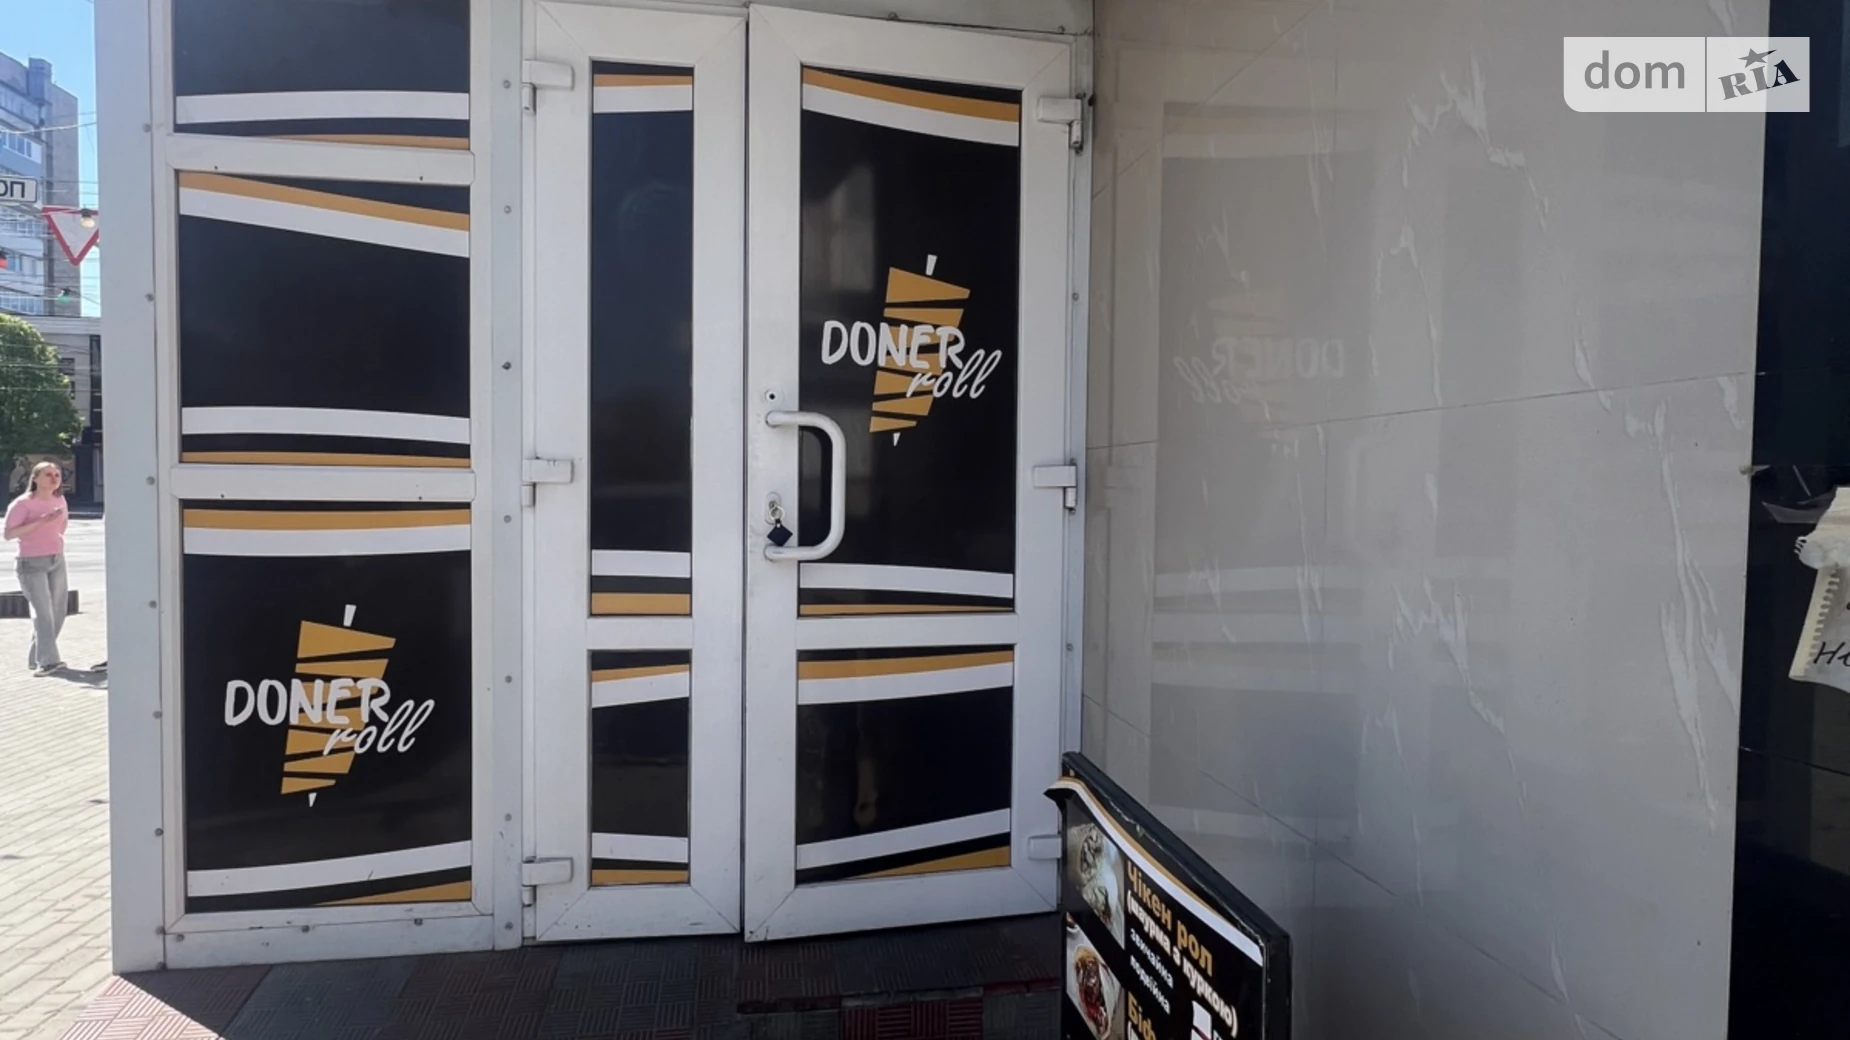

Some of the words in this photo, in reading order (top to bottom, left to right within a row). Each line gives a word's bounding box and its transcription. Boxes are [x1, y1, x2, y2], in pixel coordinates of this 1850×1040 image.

[821, 320, 966, 370] DONER
[906, 348, 1003, 399] roll
[224, 677, 392, 727] DONER
[322, 699, 436, 757] roll
[1127, 860, 1172, 932] Чікен
[1177, 919, 1213, 978] рол
[1126, 889, 1172, 957] (шаурма
[1172, 945, 1181, 967] з
[1182, 955, 1239, 1039] куркою)
